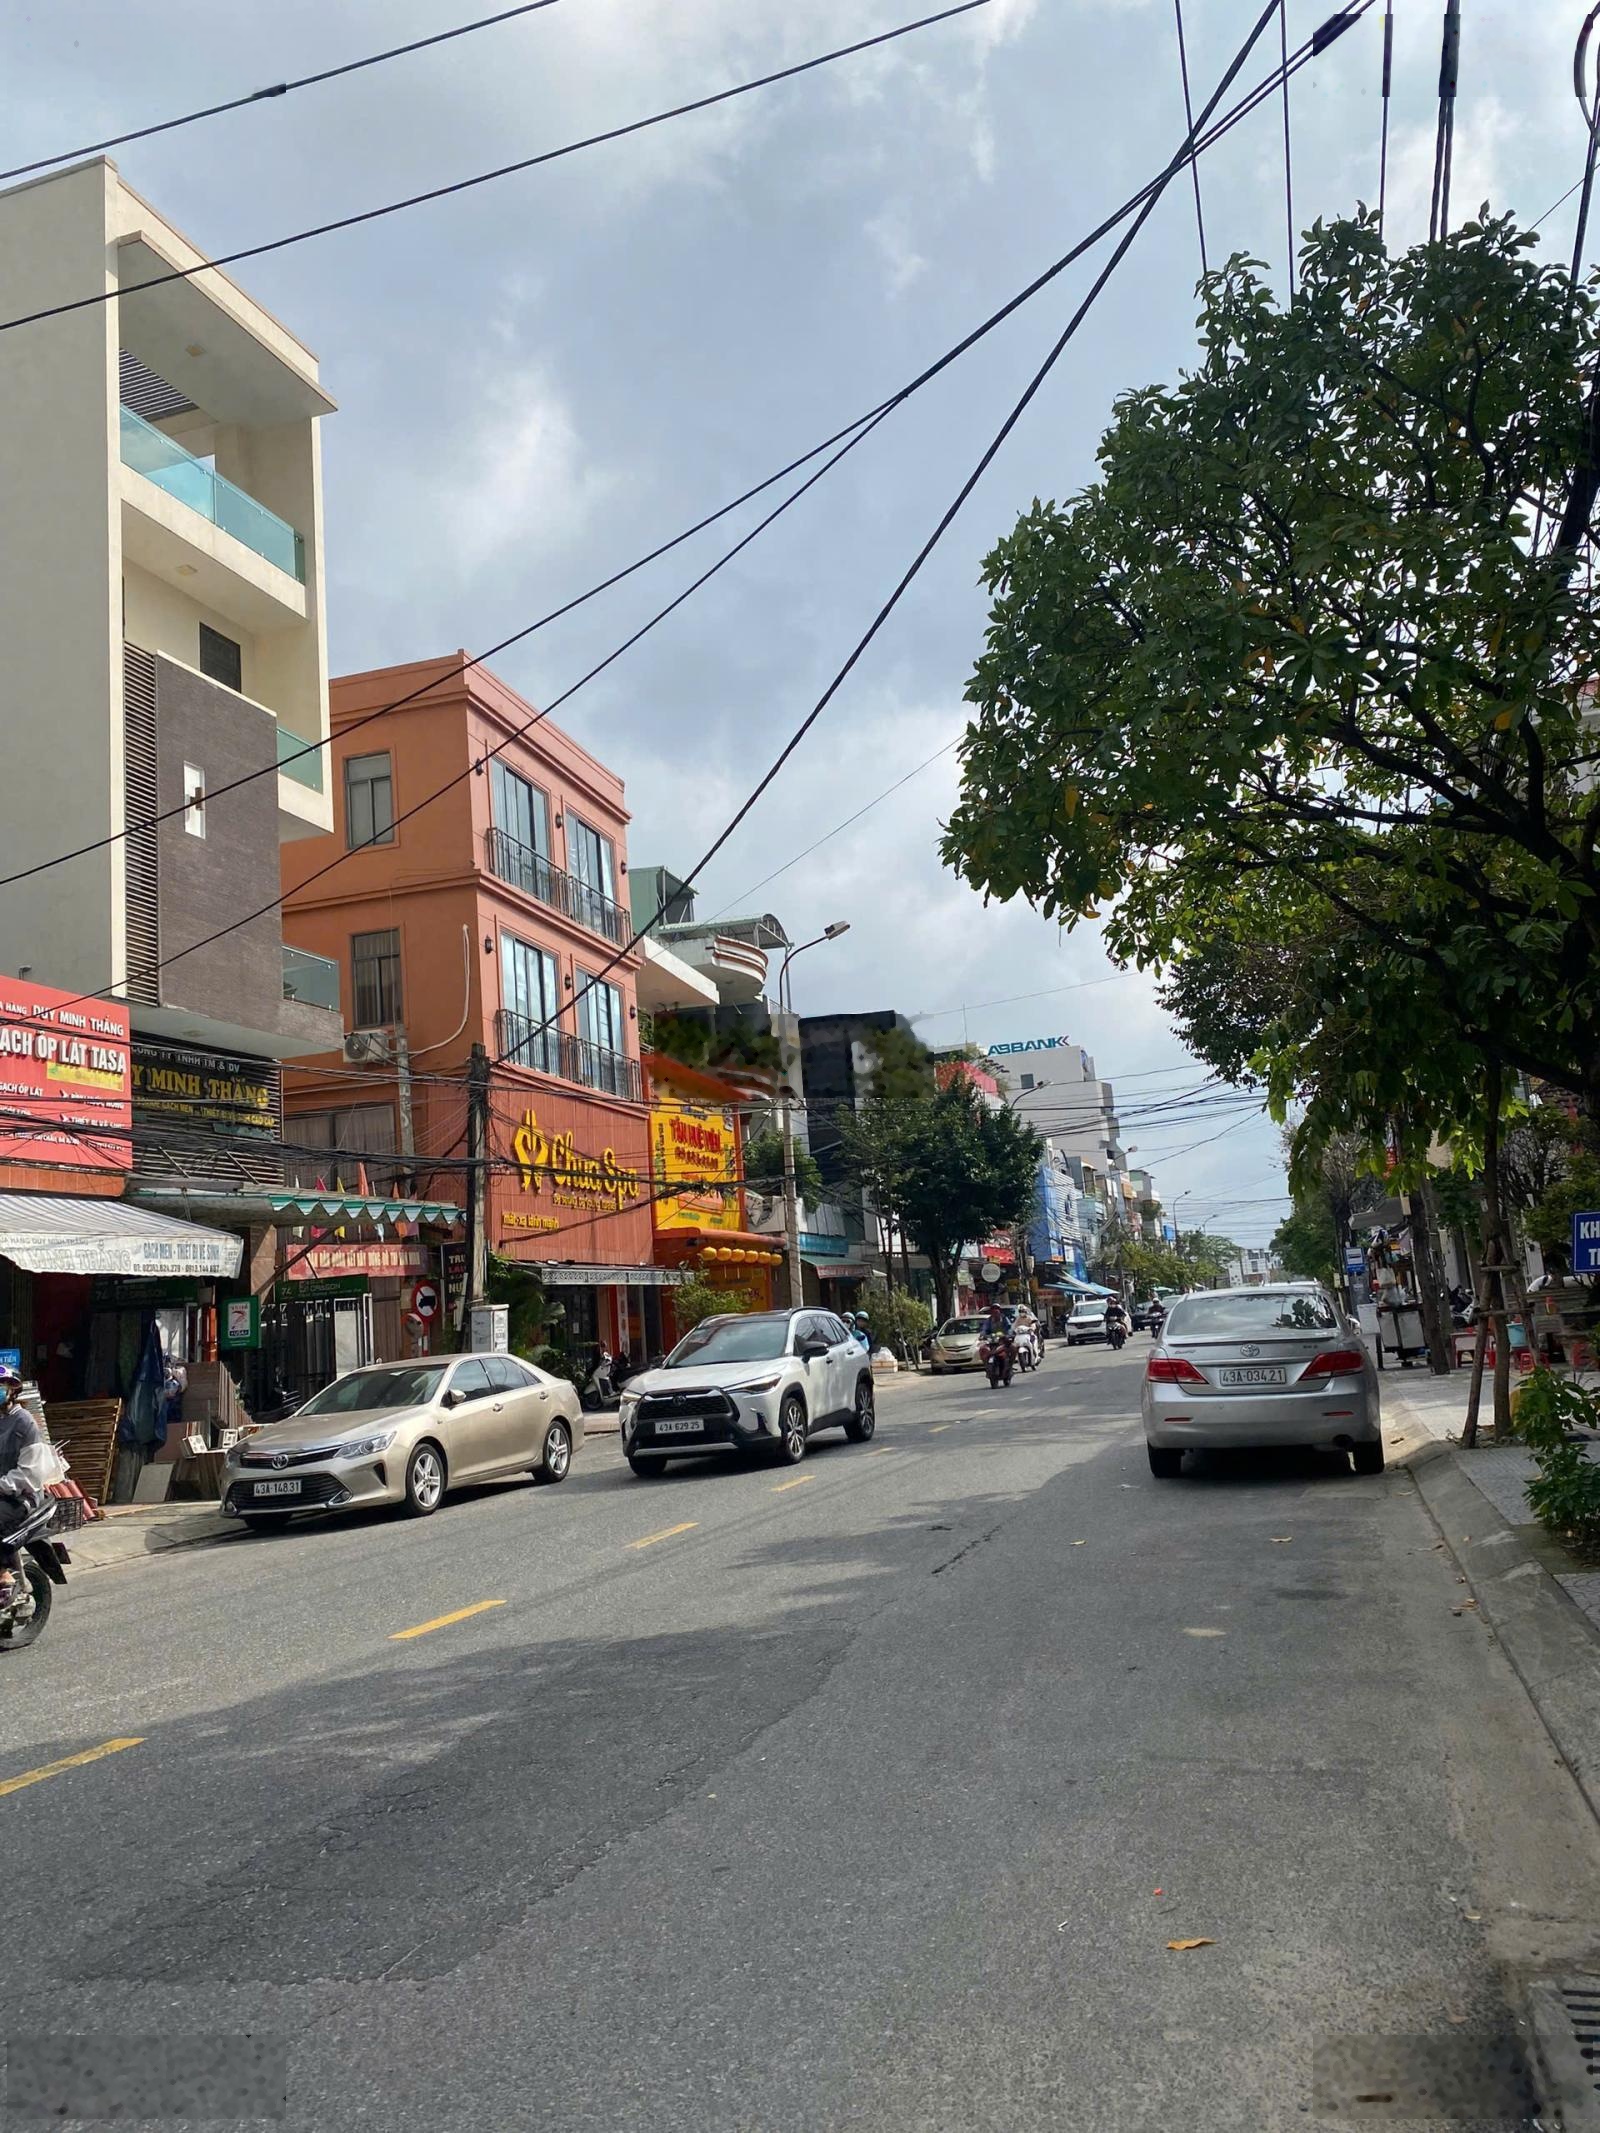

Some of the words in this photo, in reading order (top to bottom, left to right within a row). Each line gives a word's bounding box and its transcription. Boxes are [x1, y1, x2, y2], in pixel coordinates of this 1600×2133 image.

[33, 1004, 56, 1020] DUY
[59, 1011, 87, 1028] MINH
[61, 1036, 88, 1066] LÁT
[90, 1045, 128, 1074] TASA
[987, 1036, 1064, 1056] ABBANK
[228, 1062, 241, 1073] DV
[150, 1067, 201, 1096] MINH
[550, 1131, 602, 1192] Chua
[603, 1147, 640, 1211] Spa
